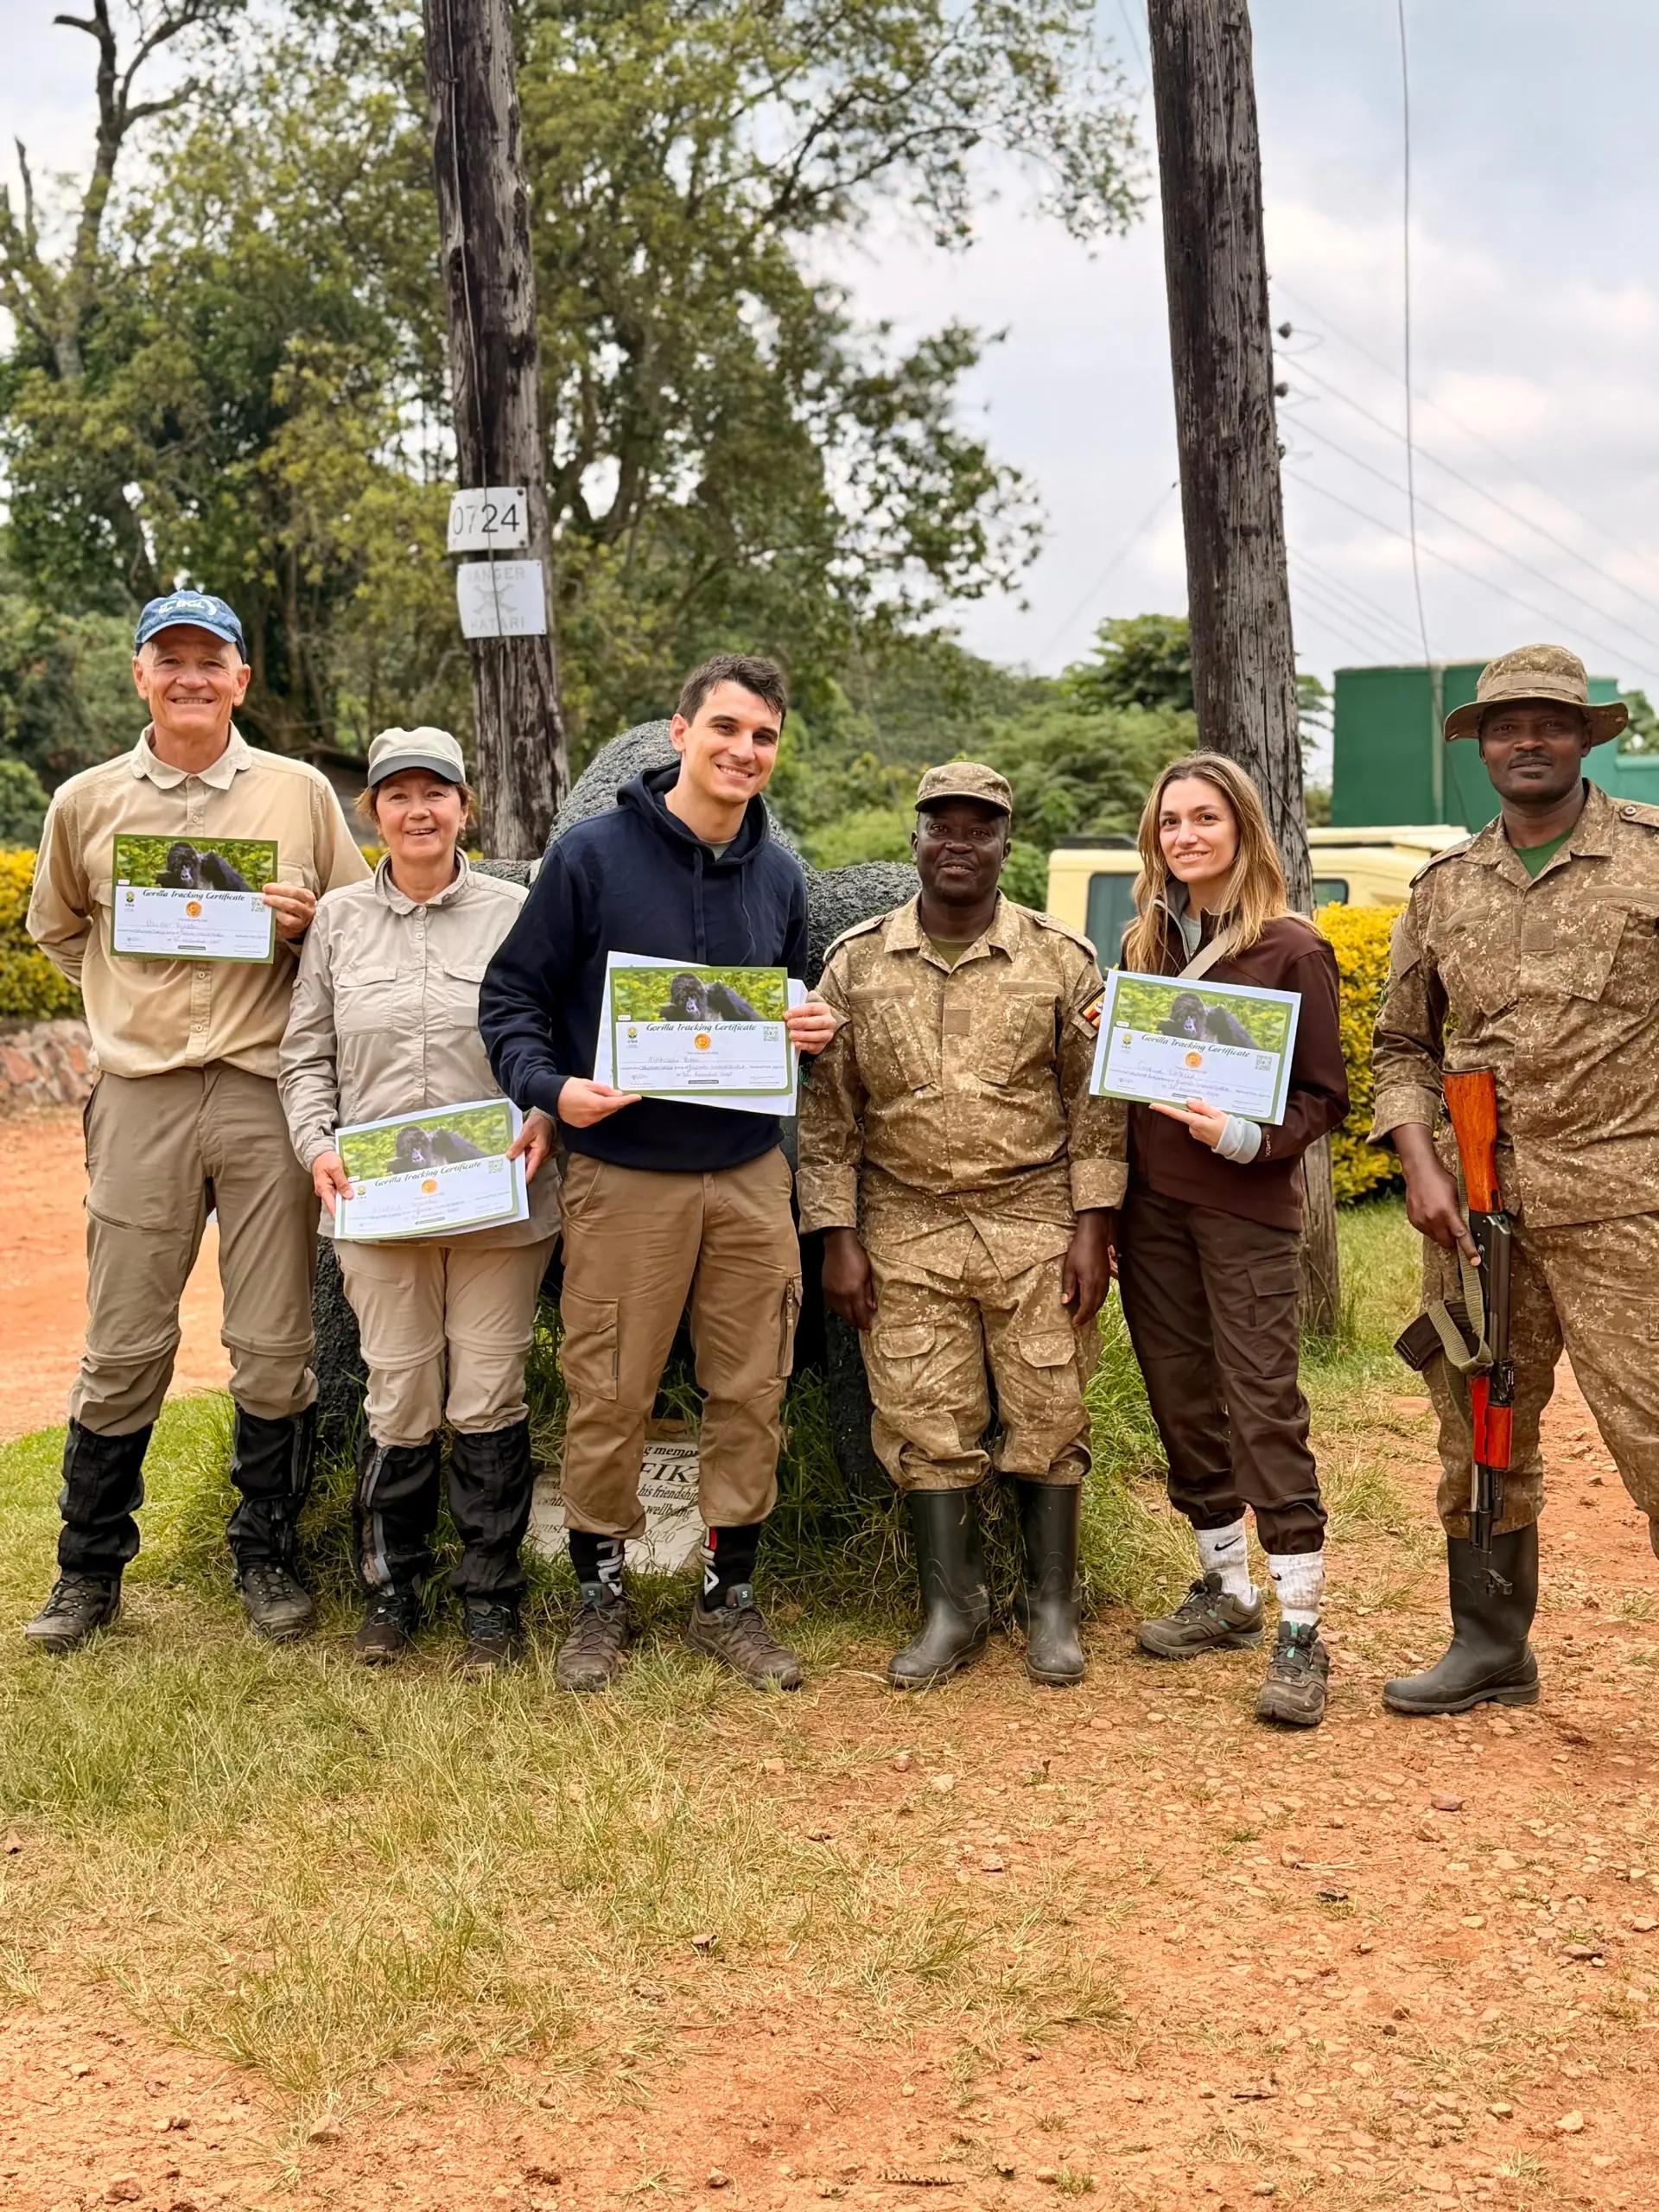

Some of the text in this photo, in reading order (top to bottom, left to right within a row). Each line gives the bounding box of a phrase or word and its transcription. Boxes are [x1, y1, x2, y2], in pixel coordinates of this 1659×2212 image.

[453, 504, 520, 536] 0724
[470, 615, 524, 632] HATARI
[143, 889, 246, 902] Gorilla Tracking Certificate
[646, 1023, 757, 1033] Gorilla Tracking Certificate
[1141, 1033, 1251, 1058] Gorilla Tracking Certificate
[374, 1160, 482, 1187] Gorilla Tracking Certificate
[653, 1446, 699, 1458] memor
[639, 1462, 700, 1484] FIK
